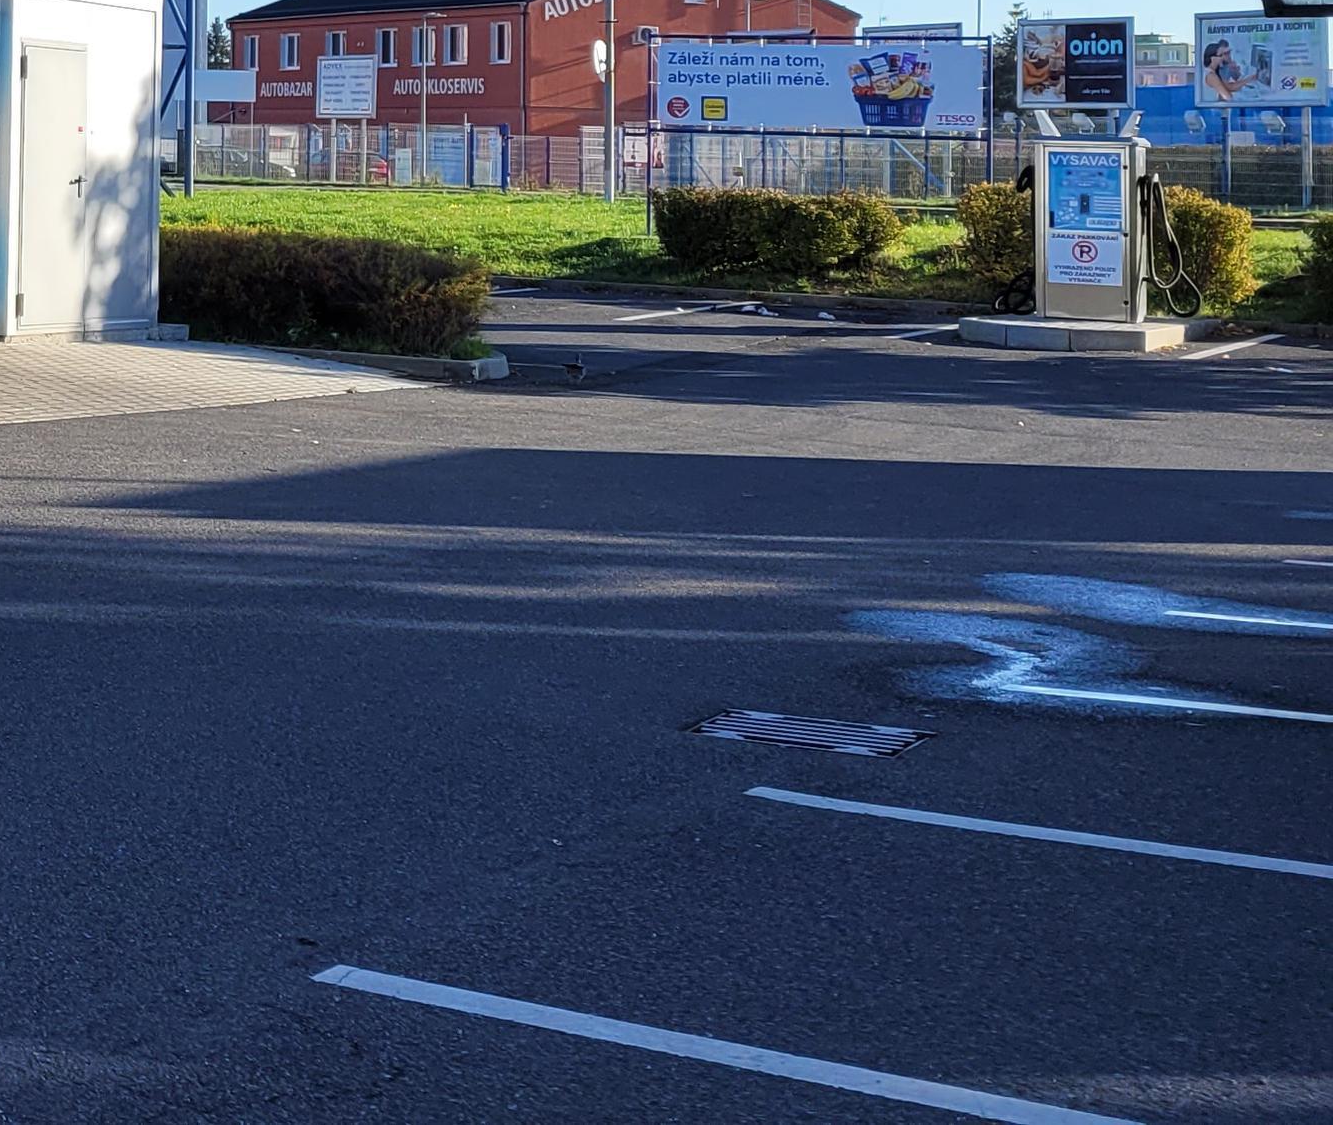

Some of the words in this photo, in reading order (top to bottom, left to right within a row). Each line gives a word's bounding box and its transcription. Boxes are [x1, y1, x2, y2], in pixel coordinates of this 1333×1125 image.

[1069, 32, 1123, 56] orion
[668, 52, 714, 65] Záleží
[719, 53, 754, 66] nám
[761, 55, 780, 66] na
[786, 54, 825, 68] tom,
[393, 78, 485, 95] AUTOKLOSERVIS
[668, 71, 721, 86] abyste
[727, 72, 771, 87] platili
[777, 72, 830, 86] méně.
[261, 82, 313, 97] AUTOBAZAR
[937, 114, 976, 123] TESCO
[1050, 154, 1119, 167] VYSAVAČ
